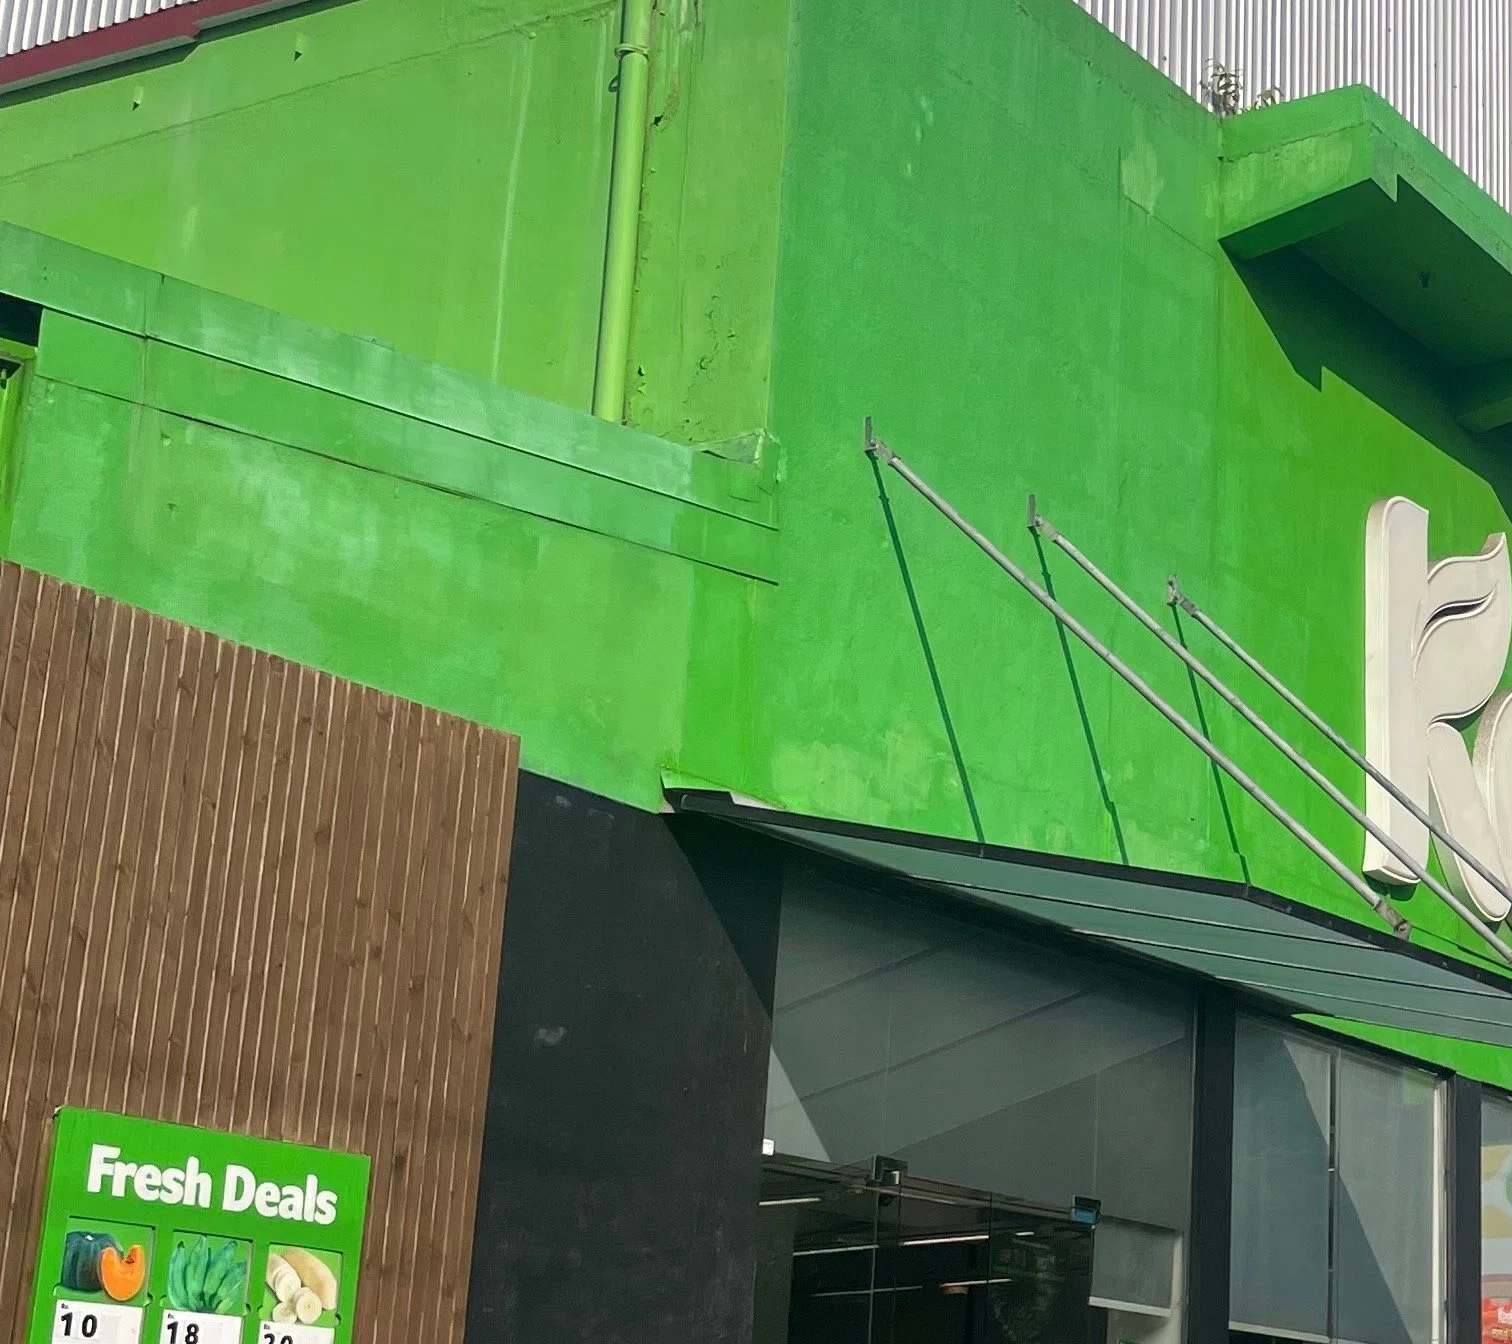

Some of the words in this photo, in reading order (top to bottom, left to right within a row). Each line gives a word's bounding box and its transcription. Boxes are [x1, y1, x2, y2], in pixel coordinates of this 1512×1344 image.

[87, 1143, 213, 1208] Fresh
[221, 1164, 338, 1225] Deals
[60, 1312, 98, 1338] 10
